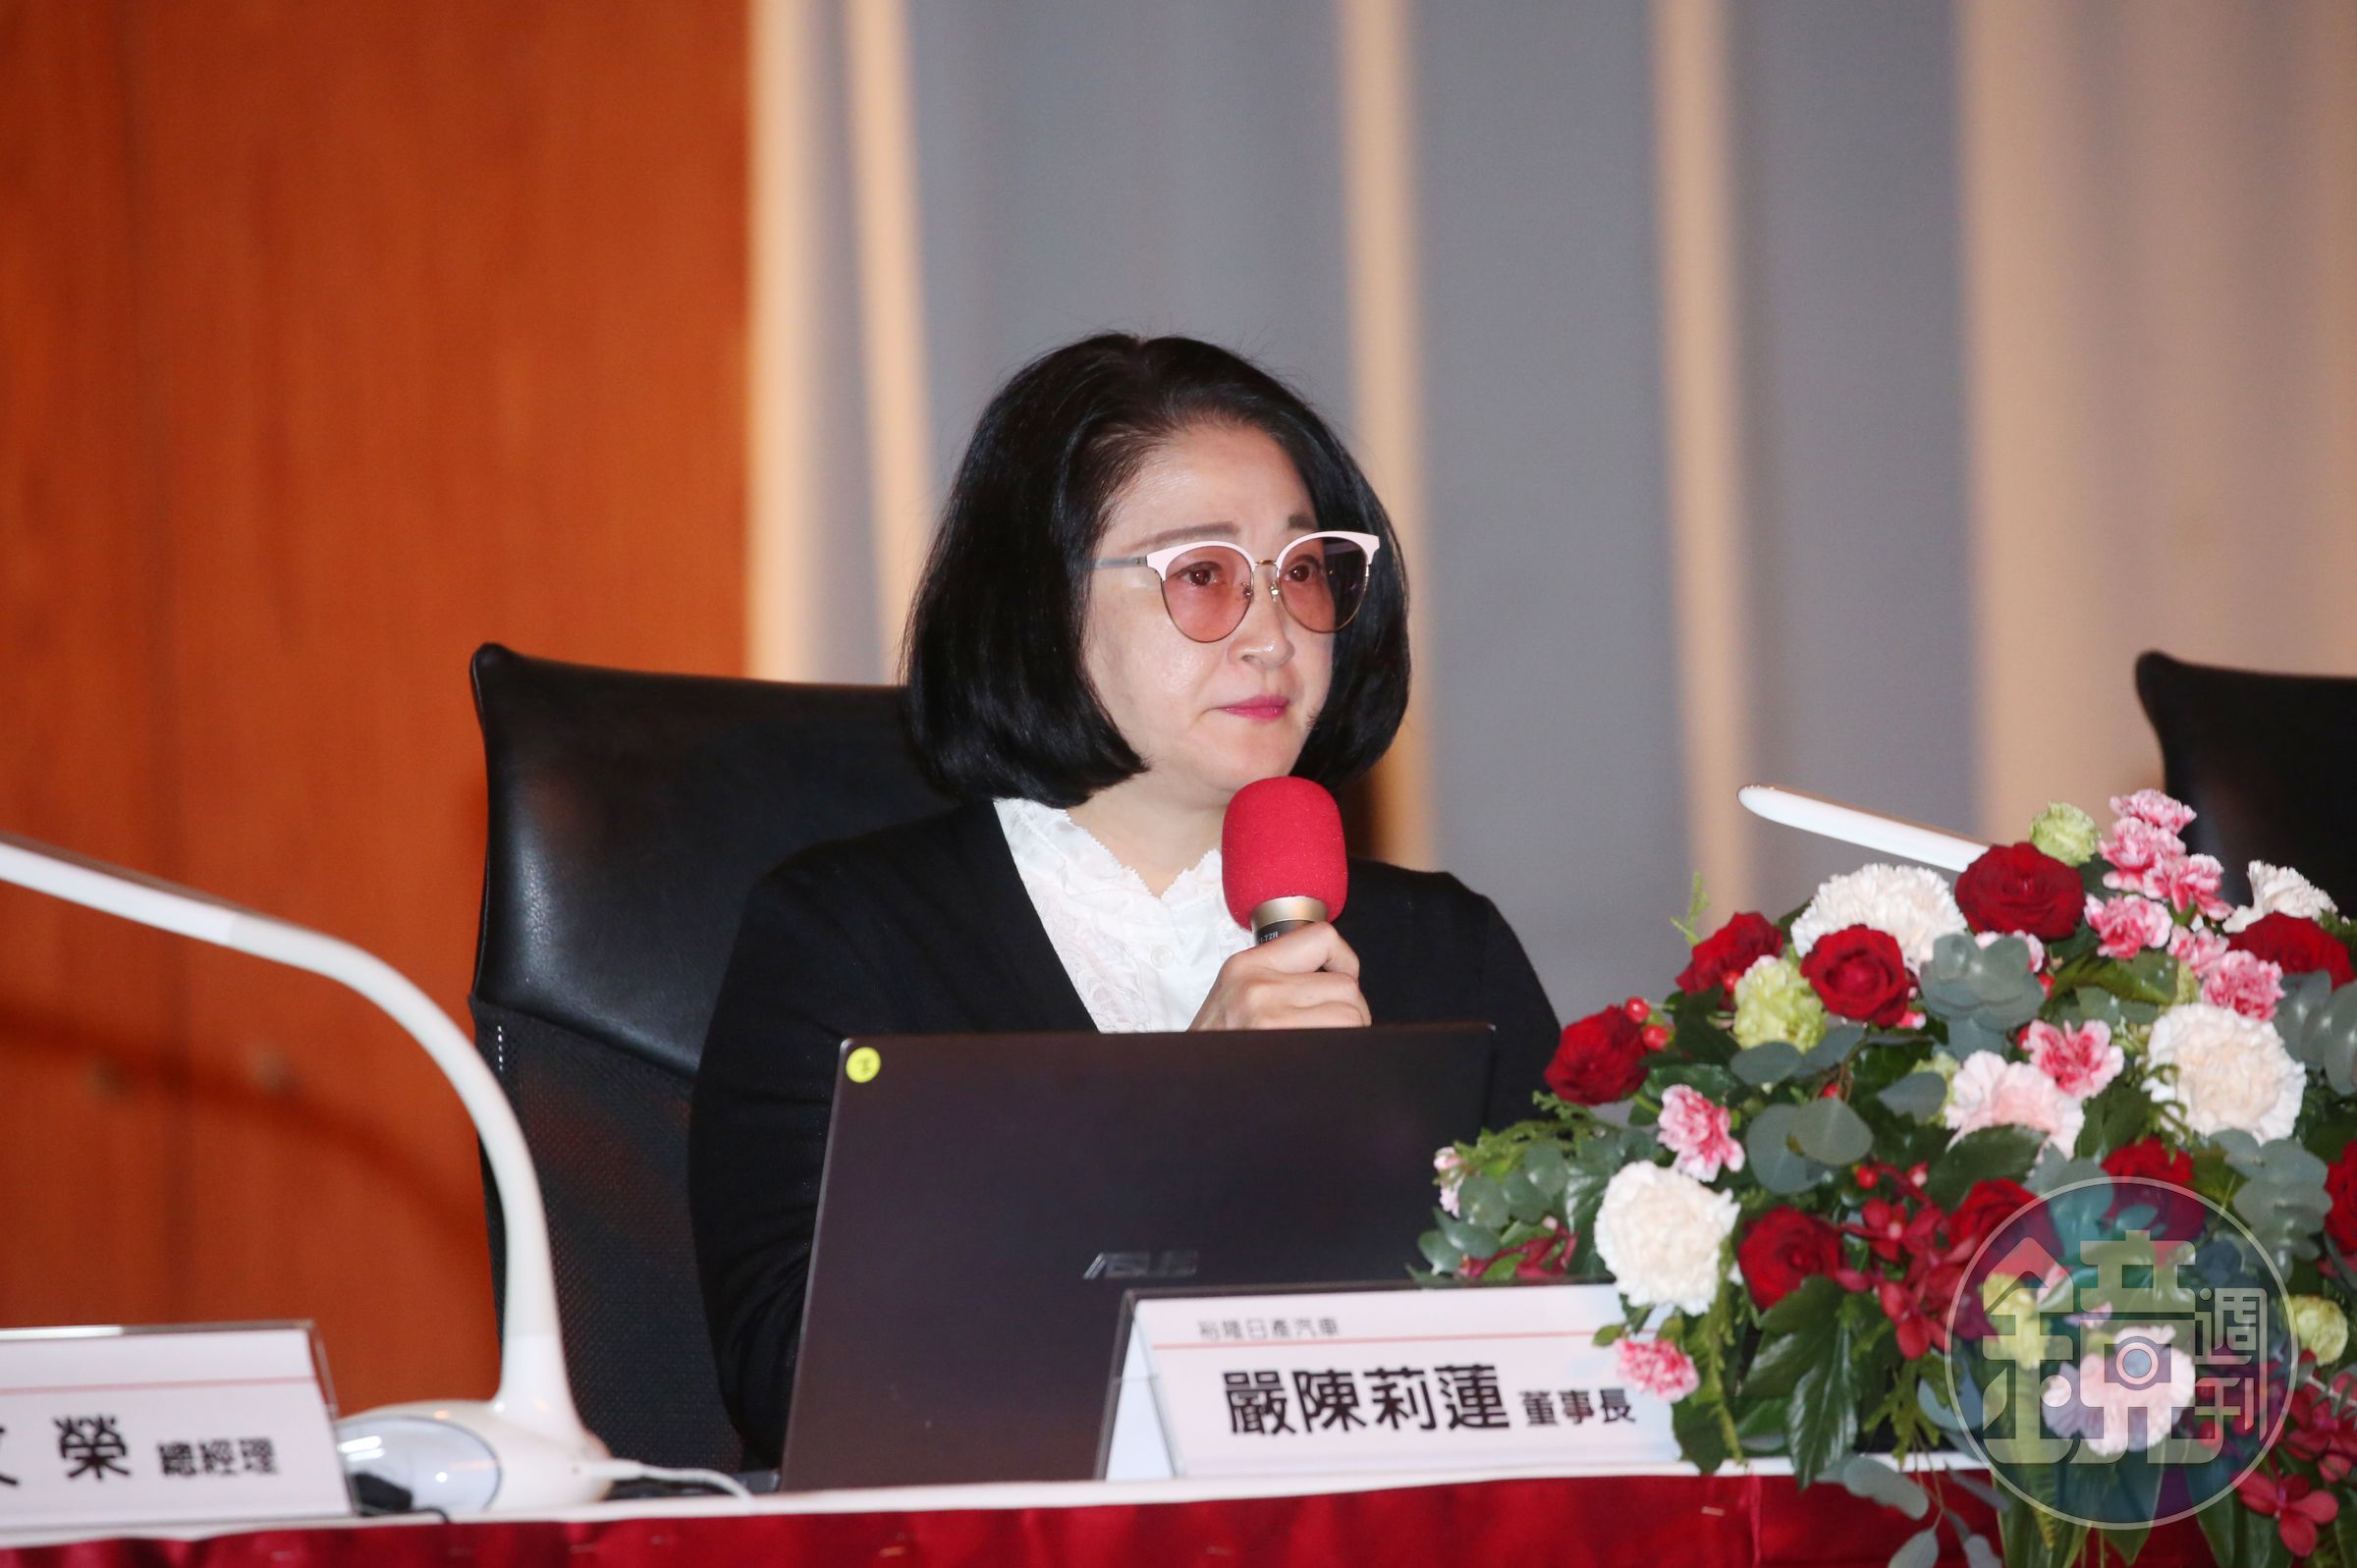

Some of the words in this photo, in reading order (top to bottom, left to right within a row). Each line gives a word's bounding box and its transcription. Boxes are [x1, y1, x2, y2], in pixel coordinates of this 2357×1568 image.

[1223, 1364, 1510, 1435] 嚴陳莉蓮
[1518, 1387, 1637, 1427] 董事長
[0, 1415, 131, 1487] 榮
[156, 1436, 278, 1477] 總經理
